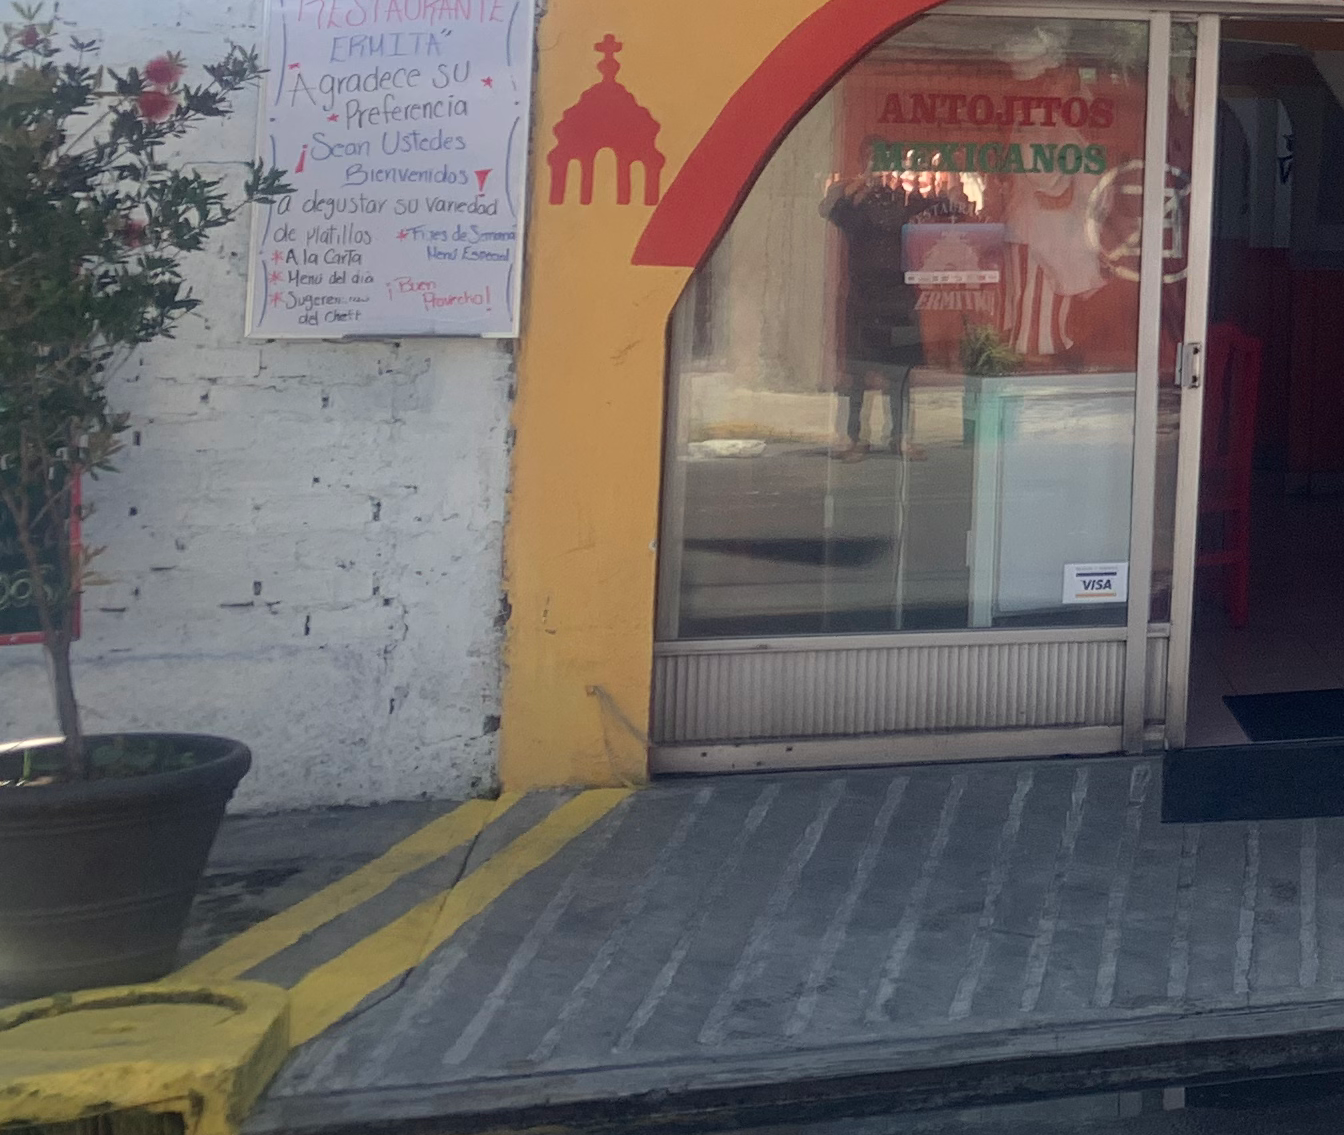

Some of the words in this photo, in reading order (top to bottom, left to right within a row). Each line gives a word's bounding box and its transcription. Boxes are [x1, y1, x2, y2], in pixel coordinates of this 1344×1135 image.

[287, 66, 421, 112] Agradece
[345, 93, 468, 130] Preferencia
[877, 92, 1115, 128] ANTOJITOS
[382, 128, 466, 156] Ustedes
[871, 140, 1107, 175] MEXICANOS
[302, 188, 388, 220] degustar
[273, 222, 296, 243] de
[303, 248, 318, 265] la
[285, 290, 370, 311] Sugeren
[1081, 579, 1112, 590] VISA
